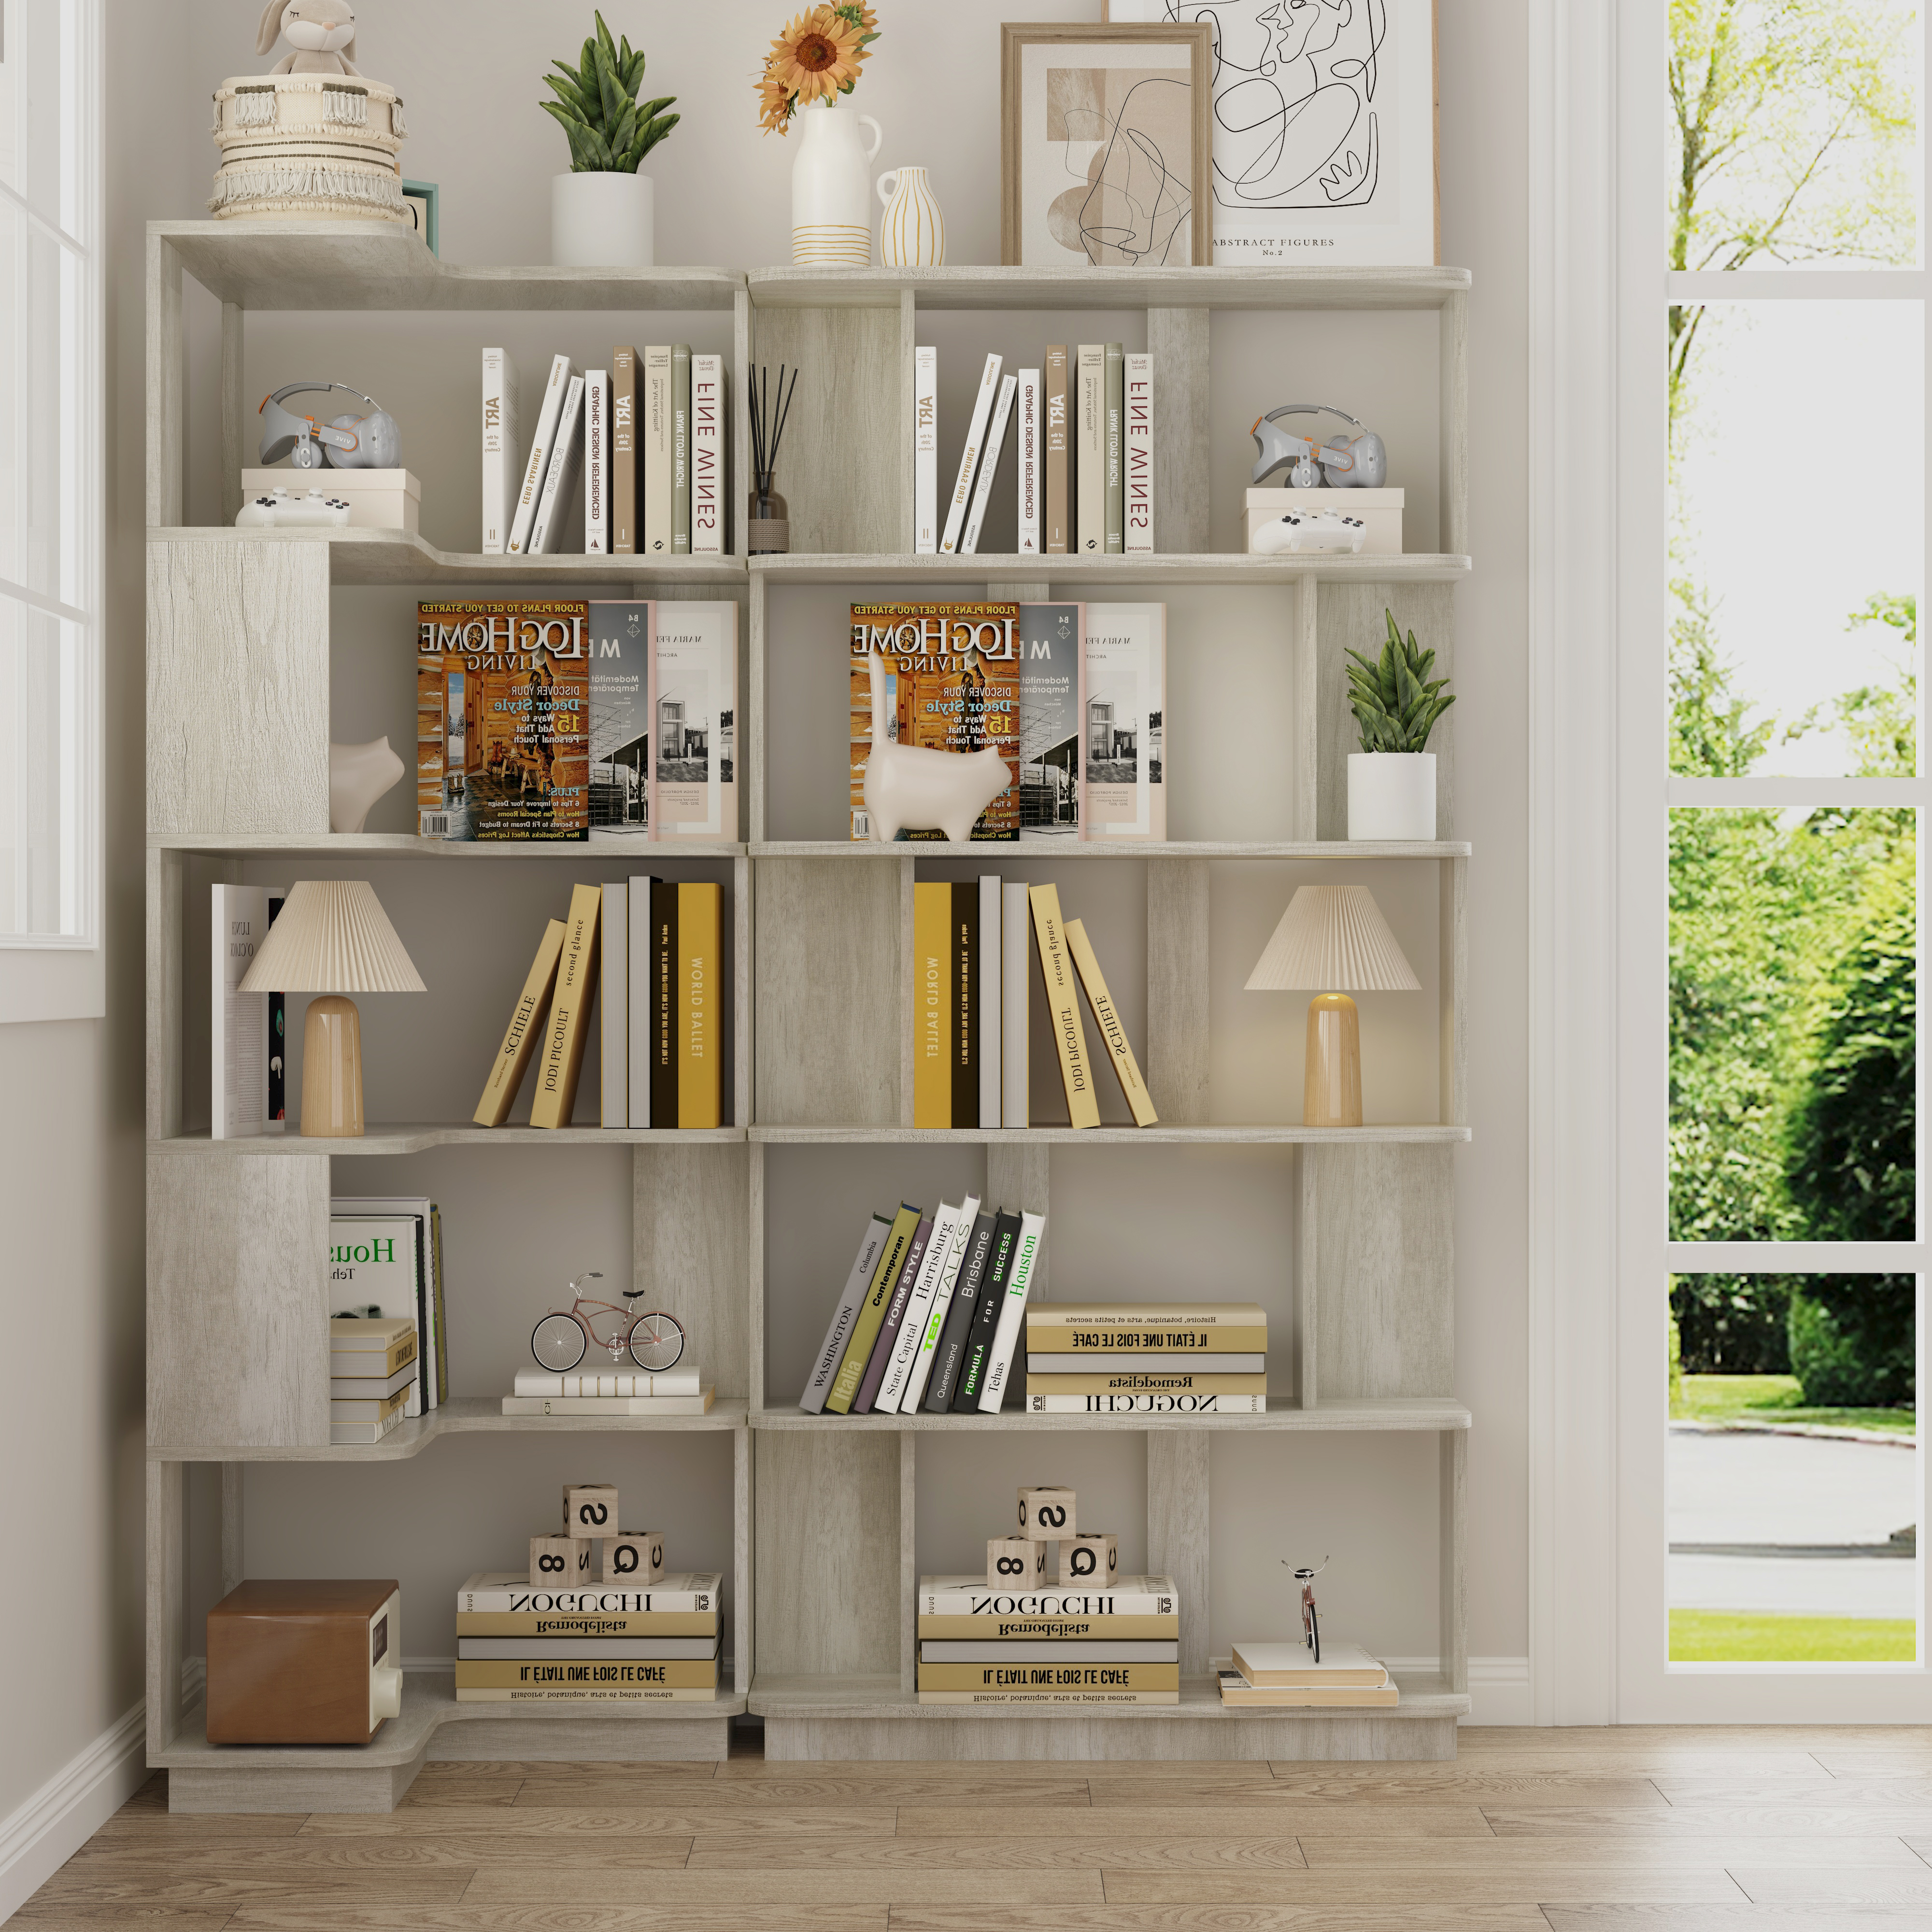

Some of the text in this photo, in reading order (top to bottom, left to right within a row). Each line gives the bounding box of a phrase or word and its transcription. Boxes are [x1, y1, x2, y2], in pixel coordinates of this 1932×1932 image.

[566, 920, 583, 986] second glance
[505, 995, 536, 1055] SCHIELE
[691, 957, 703, 1058] WORLD BALLET
[545, 1008, 569, 1092] JODI PICOULT
[859, 1241, 877, 1273] Columbia
[872, 1236, 905, 1307] Contemporan
[888, 1241, 923, 1327] FORM STYLE
[916, 1222, 954, 1300] Harrisburg
[923, 1224, 970, 1352] TED TALKS
[962, 1231, 990, 1298] Brisbane
[1009, 1236, 1037, 1298] Houston
[814, 1306, 853, 1388] WASHINGTON
[965, 1233, 1012, 1395] FORMULA FOR SUCCESS
[833, 1360, 863, 1401] Italia
[887, 1323, 918, 1396] State Capital
[938, 1344, 958, 1398] Queensland
[988, 1362, 1005, 1392] Tehas
